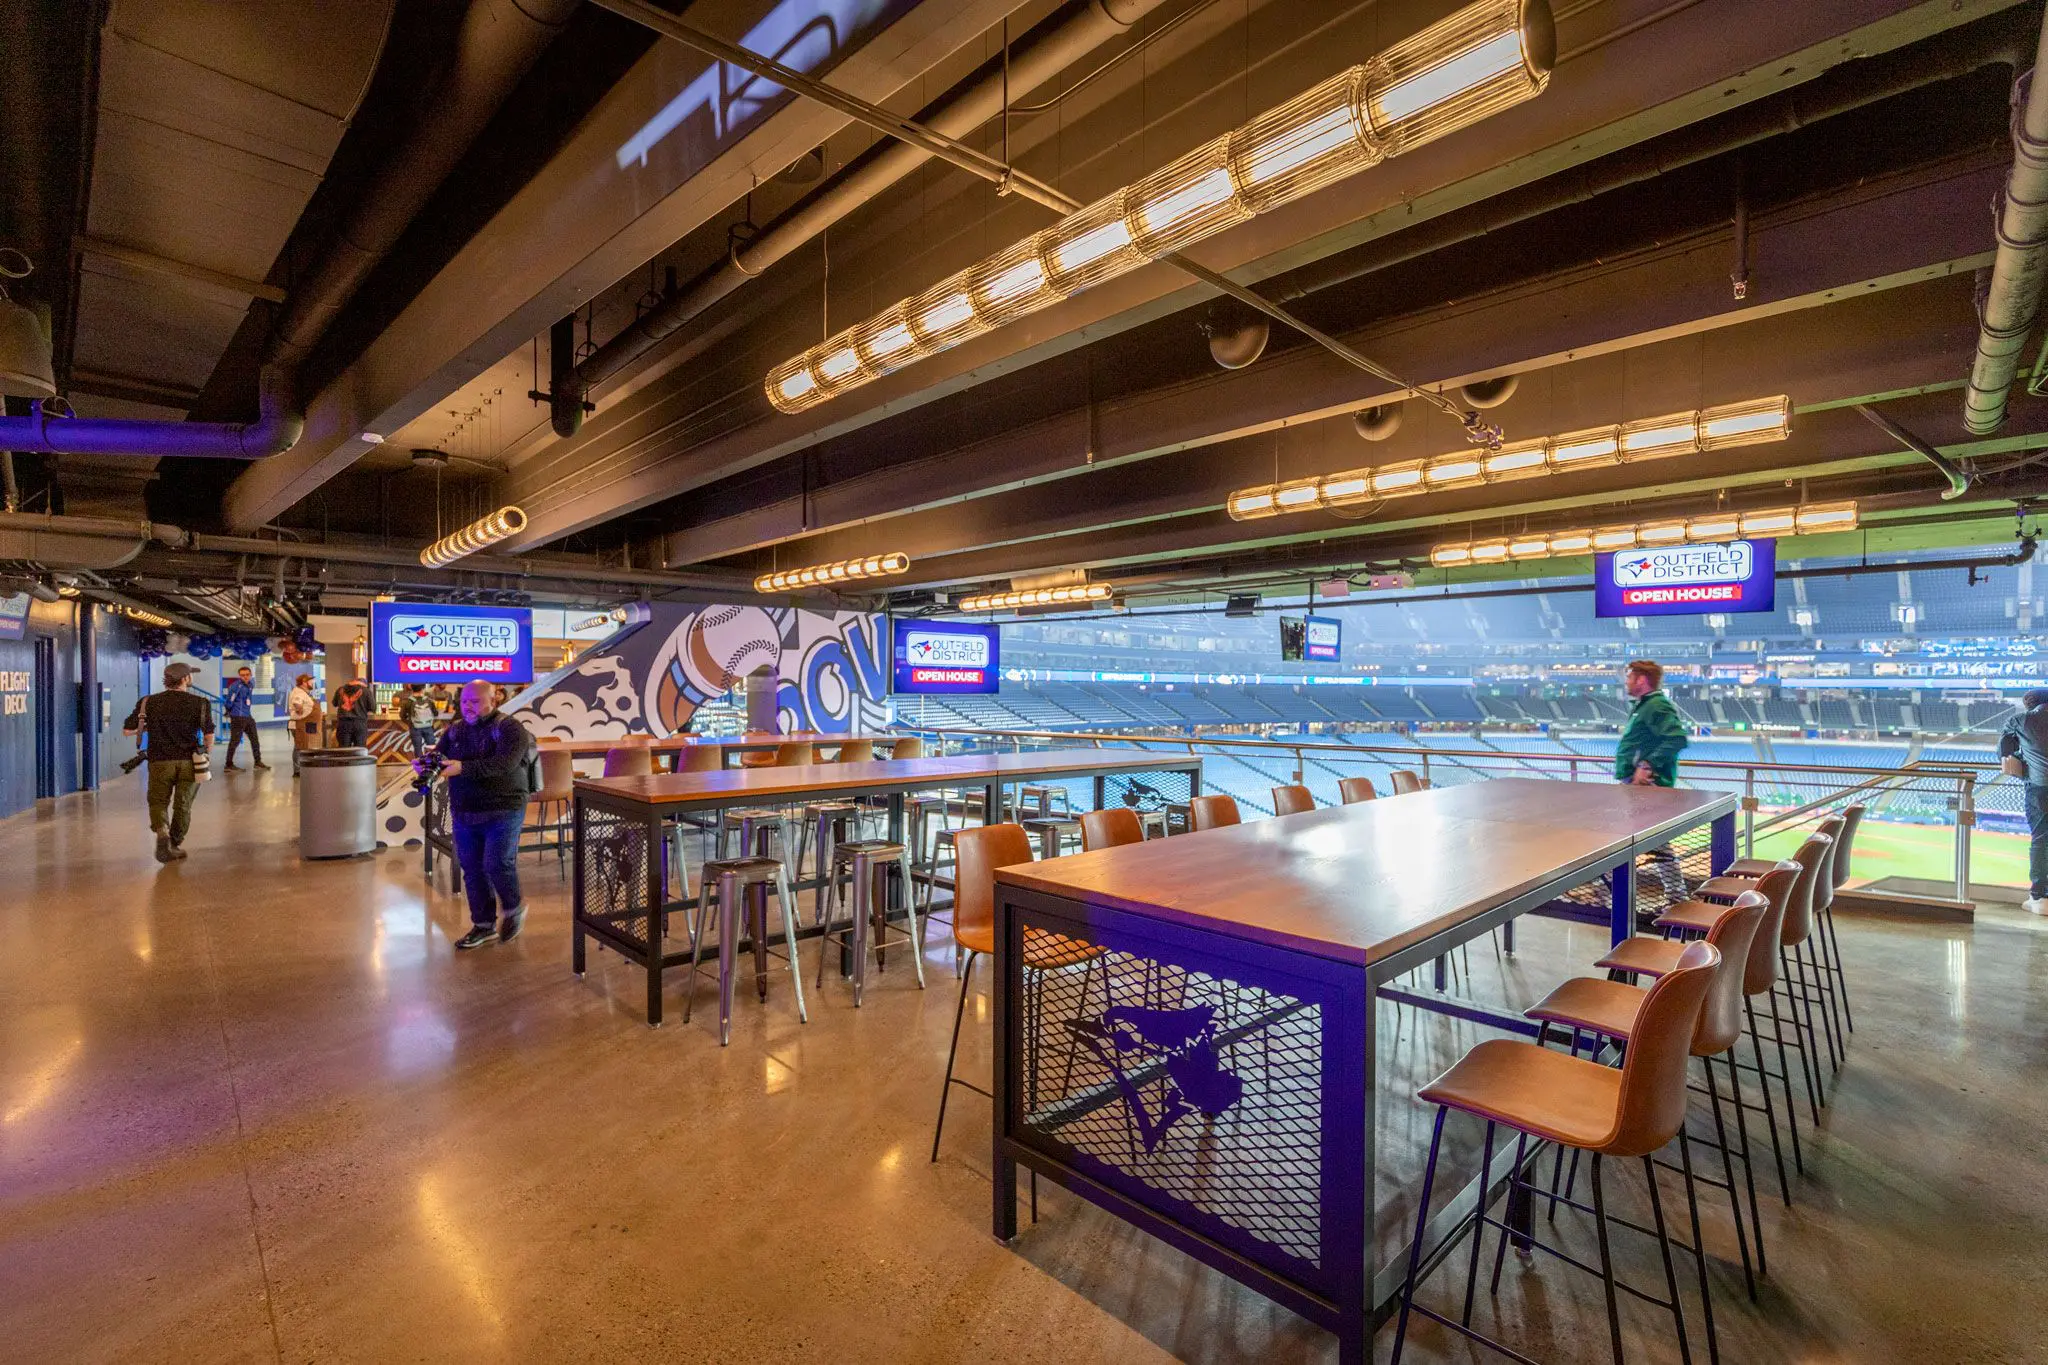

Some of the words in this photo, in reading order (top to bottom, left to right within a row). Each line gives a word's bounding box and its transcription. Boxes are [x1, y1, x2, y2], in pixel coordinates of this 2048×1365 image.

[1653, 550, 1743, 567] OUTFIELD
[1653, 562, 1743, 578] DISTRICT
[1630, 589, 1674, 603] OPEN
[1676, 586, 1733, 601] HOUSE
[430, 623, 511, 637] OUTFIELD
[430, 636, 511, 649] DISTRICT
[932, 640, 984, 652] OUTFIELD
[932, 650, 984, 662] DISTRICT
[407, 659, 451, 672] OPEN
[452, 659, 504, 671] HOUSE
[0, 671, 30, 692] FLIGHT
[917, 670, 945, 682] OPEN
[946, 671, 979, 682] HOUSE
[4, 694, 27, 715] DECK
